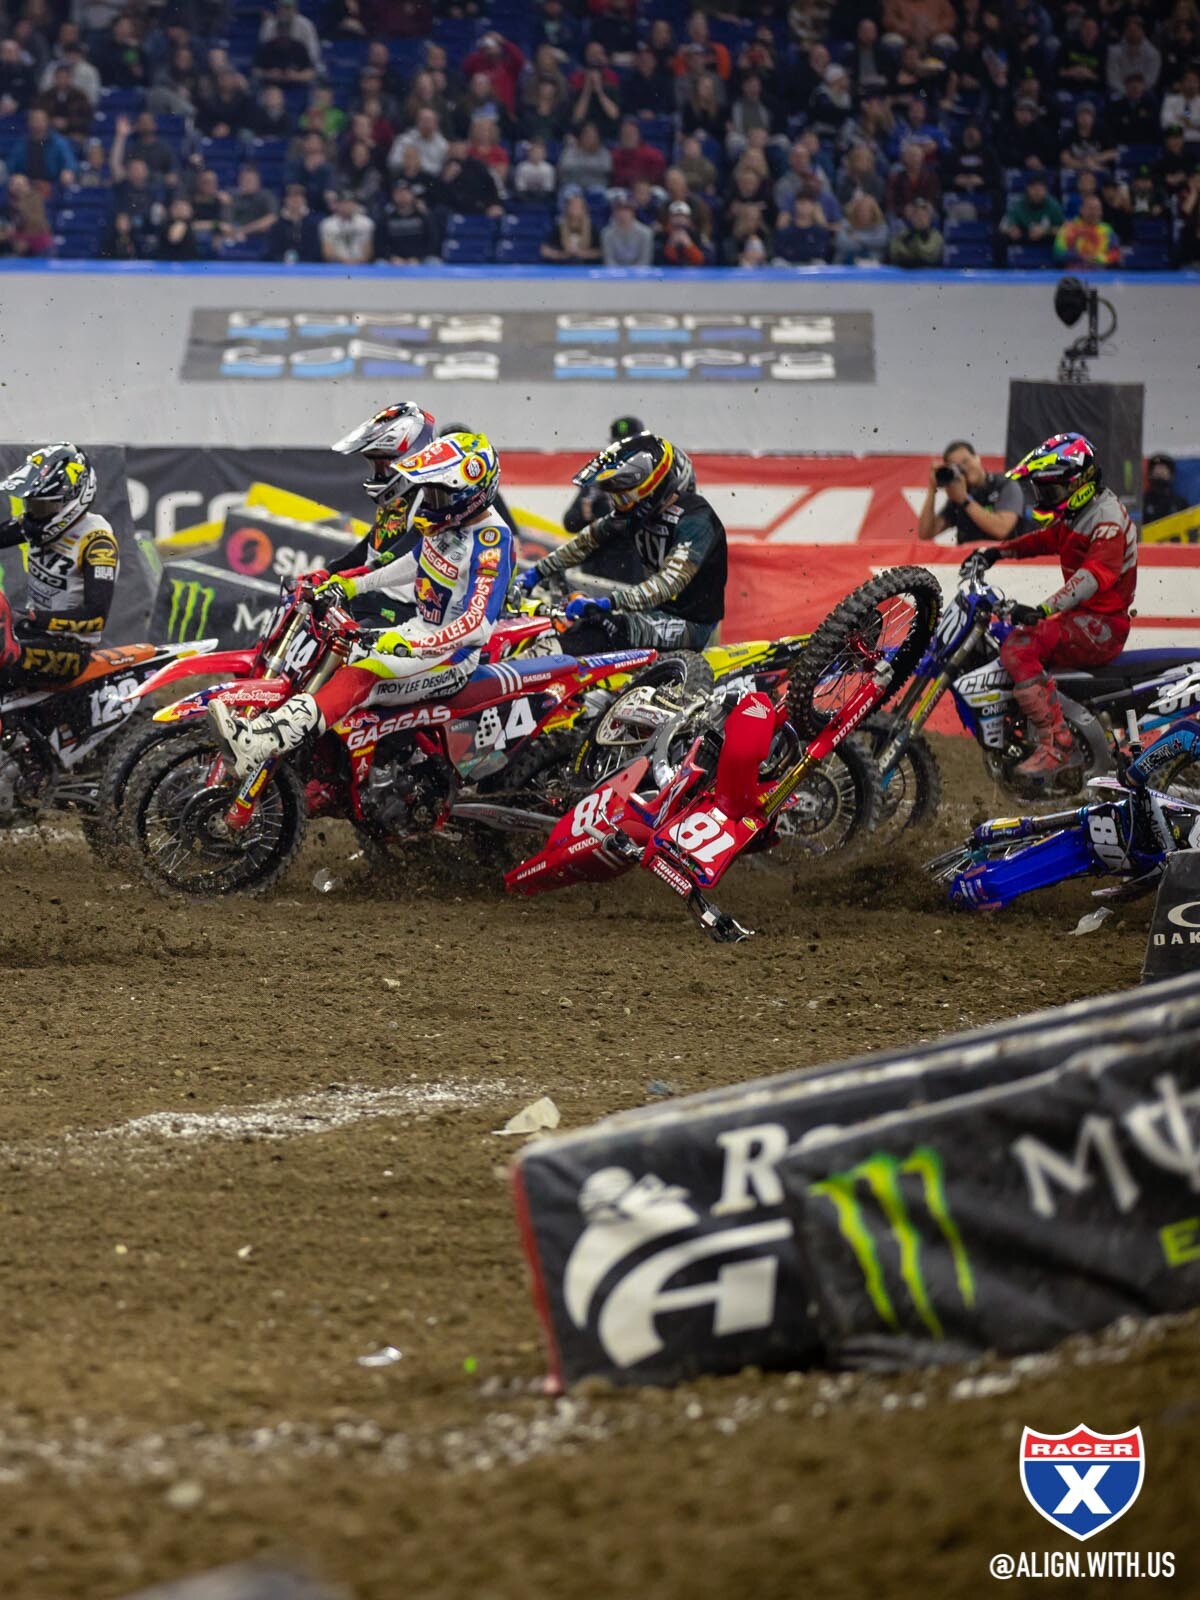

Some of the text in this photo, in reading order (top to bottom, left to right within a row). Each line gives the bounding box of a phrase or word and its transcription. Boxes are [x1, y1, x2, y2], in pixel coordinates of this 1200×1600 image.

[29, 546, 75, 575] XR
[49, 617, 105, 632] FXR
[522, 671, 552, 682] GASGAS
[613, 657, 649, 670] DUNLOP
[377, 667, 461, 695] TROY LEE DESIGN
[347, 705, 452, 752] GASGAS
[832, 696, 875, 747] DUNLOP
